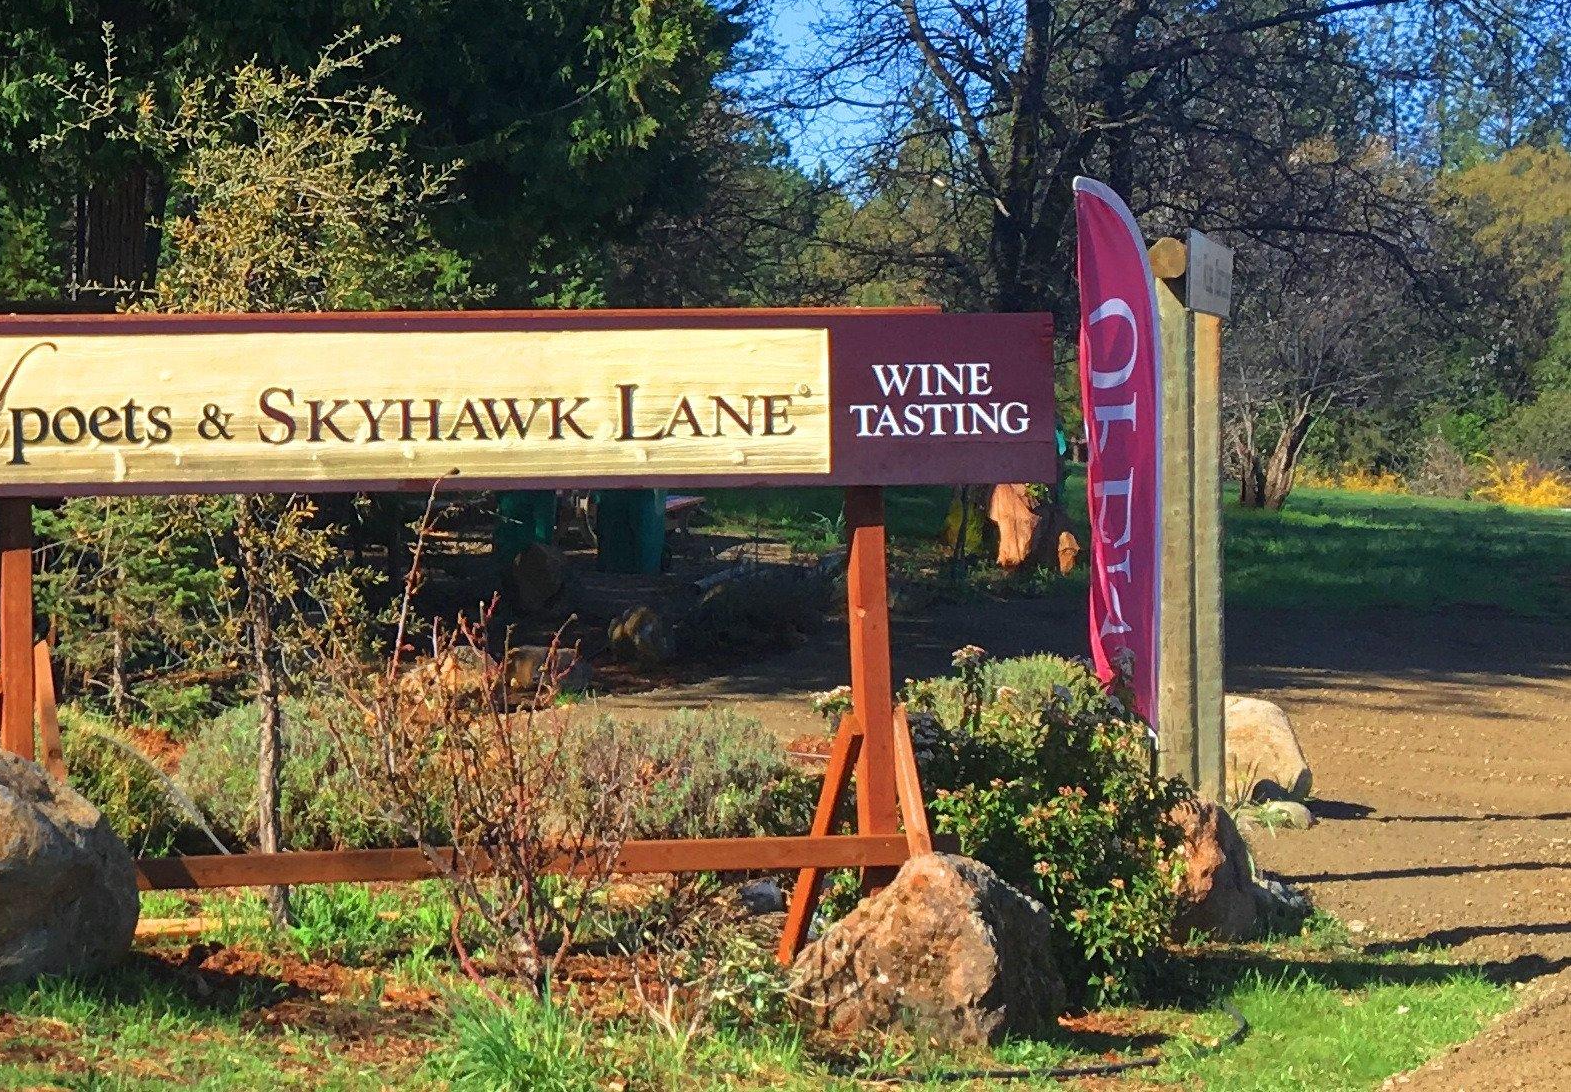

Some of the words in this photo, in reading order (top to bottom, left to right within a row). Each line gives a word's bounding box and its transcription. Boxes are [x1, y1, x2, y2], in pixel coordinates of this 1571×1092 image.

[871, 363, 993, 397] WINE
[197, 402, 235, 440] &
[257, 386, 594, 445] SKYHAWK
[614, 383, 797, 441] LANE
[849, 402, 1030, 438] TASTING
